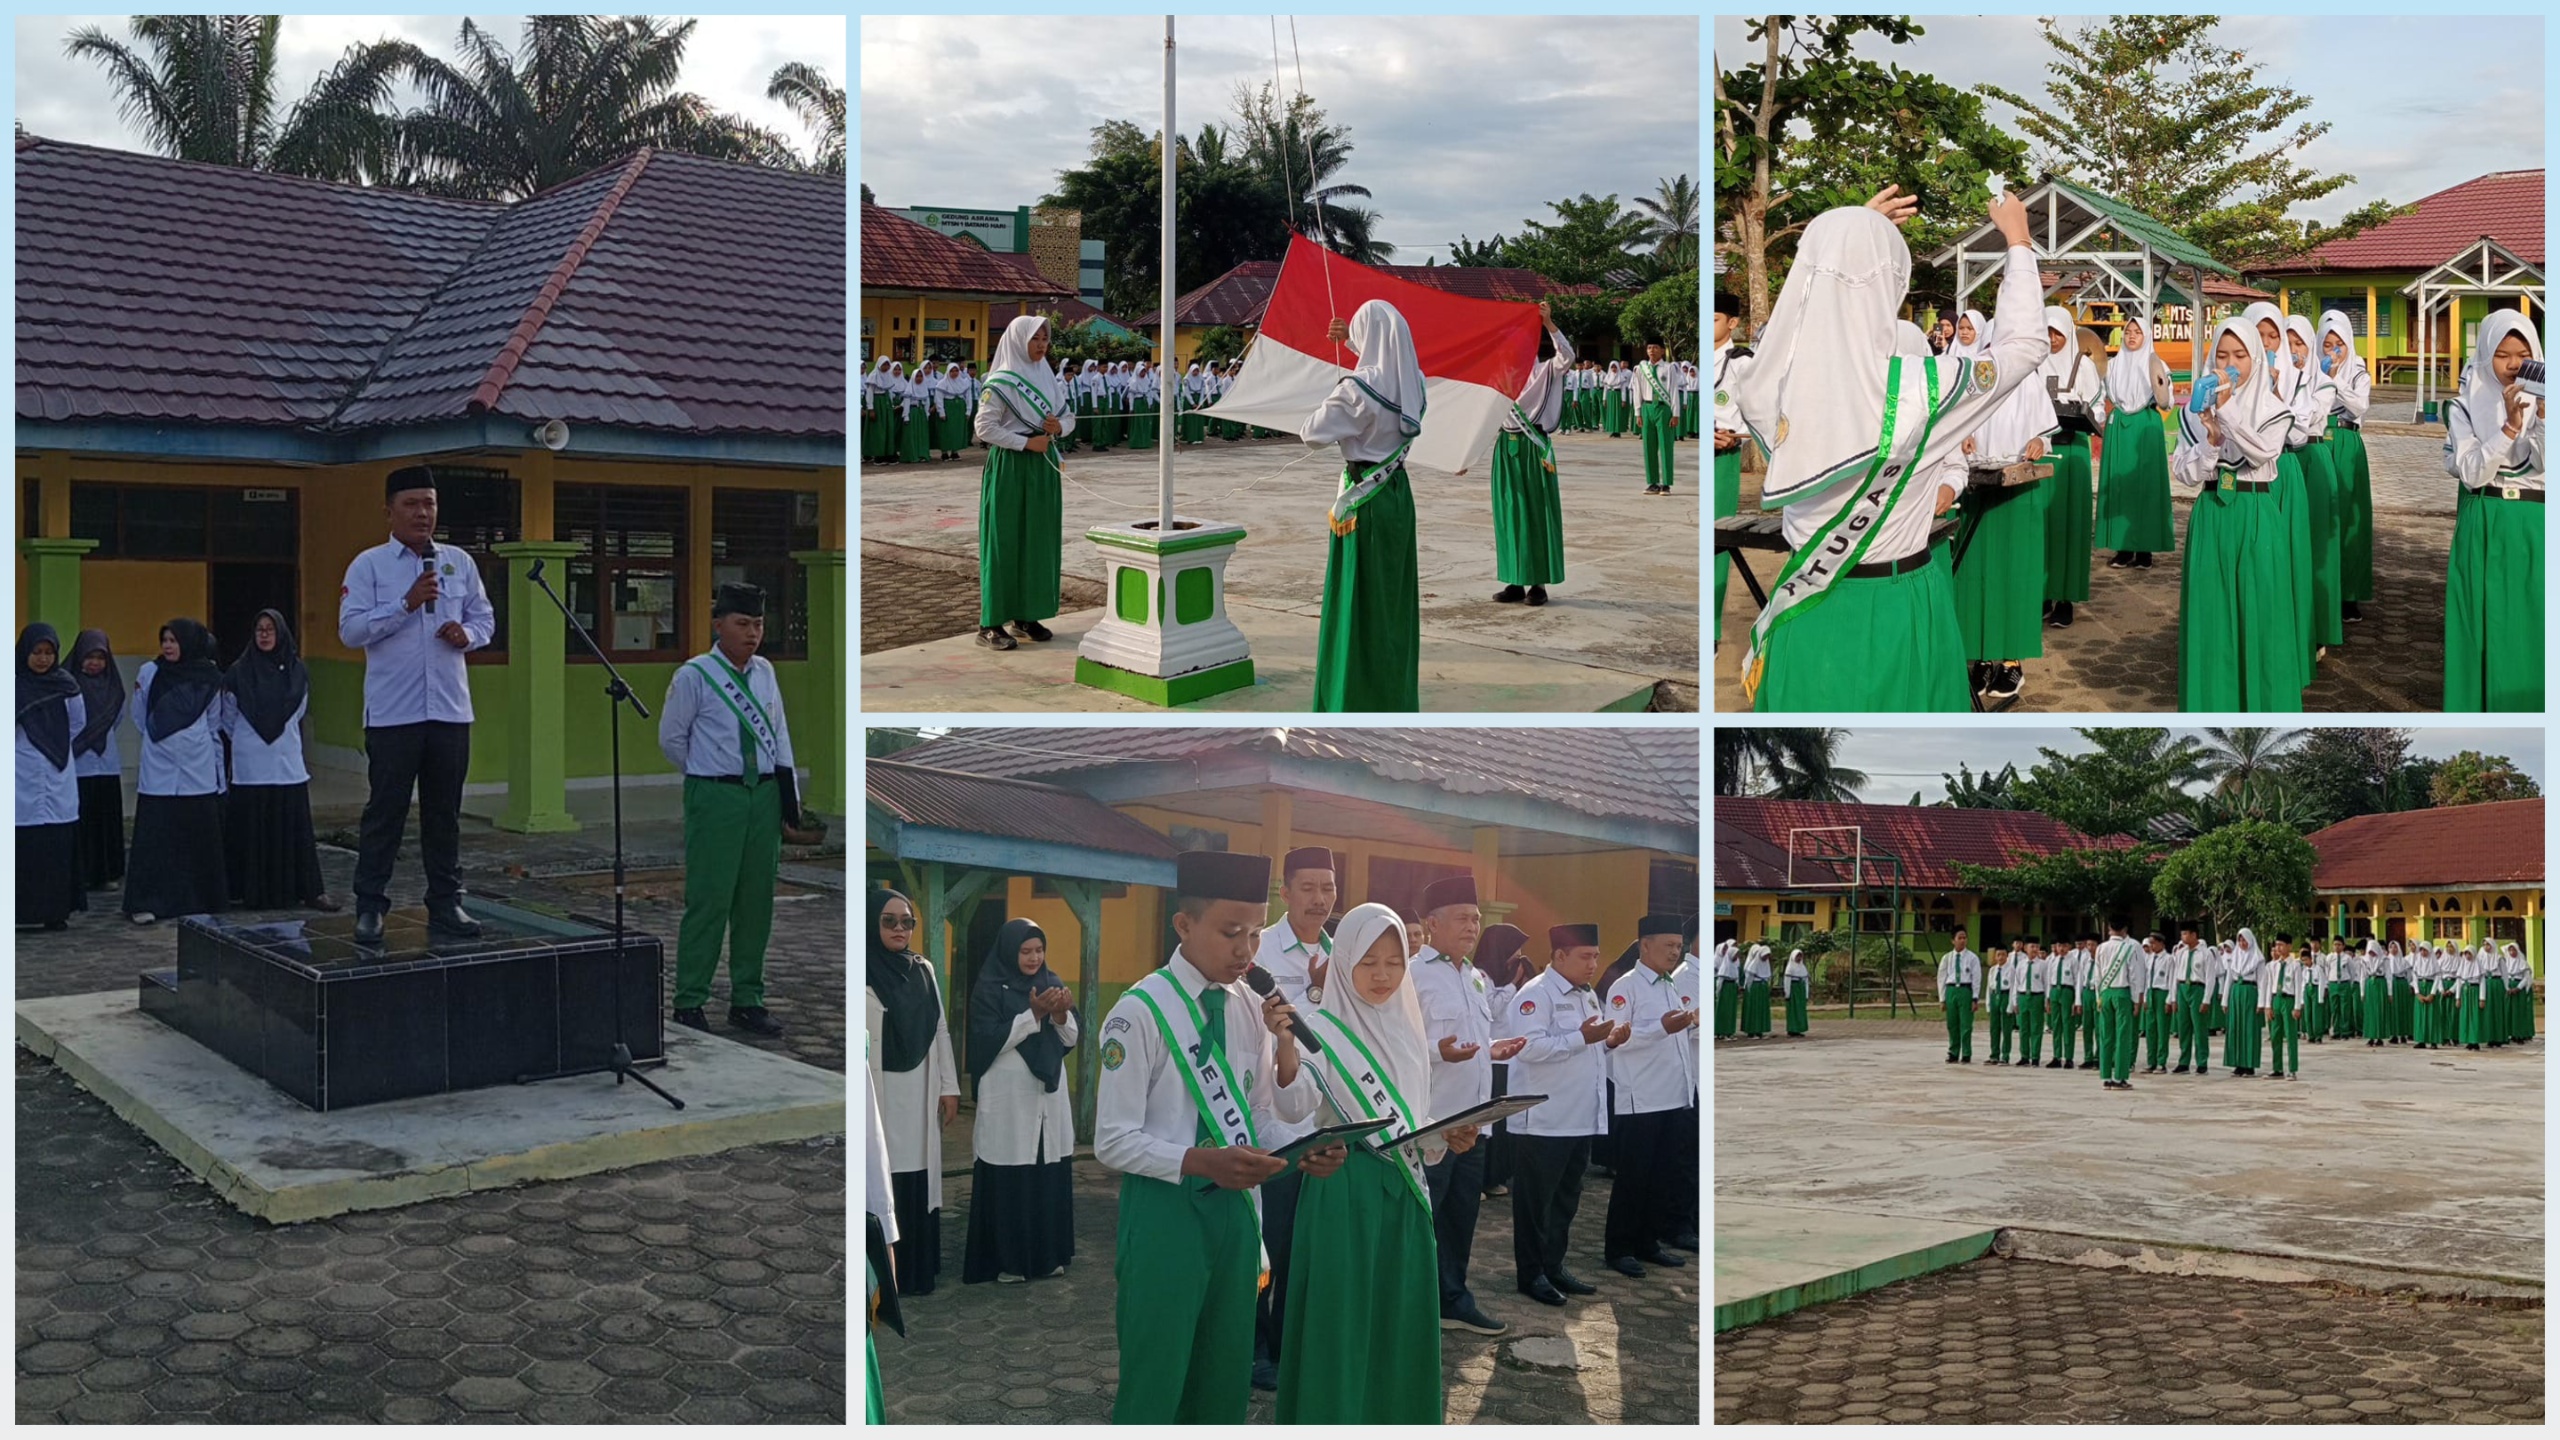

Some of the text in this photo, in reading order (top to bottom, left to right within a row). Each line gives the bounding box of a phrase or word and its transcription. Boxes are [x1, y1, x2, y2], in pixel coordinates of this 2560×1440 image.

[2170, 305, 2193, 322] MTs
[2153, 323, 2194, 340] BATAN
[1017, 381, 1051, 415] PETU
[1188, 1043, 1248, 1147] PETUG
